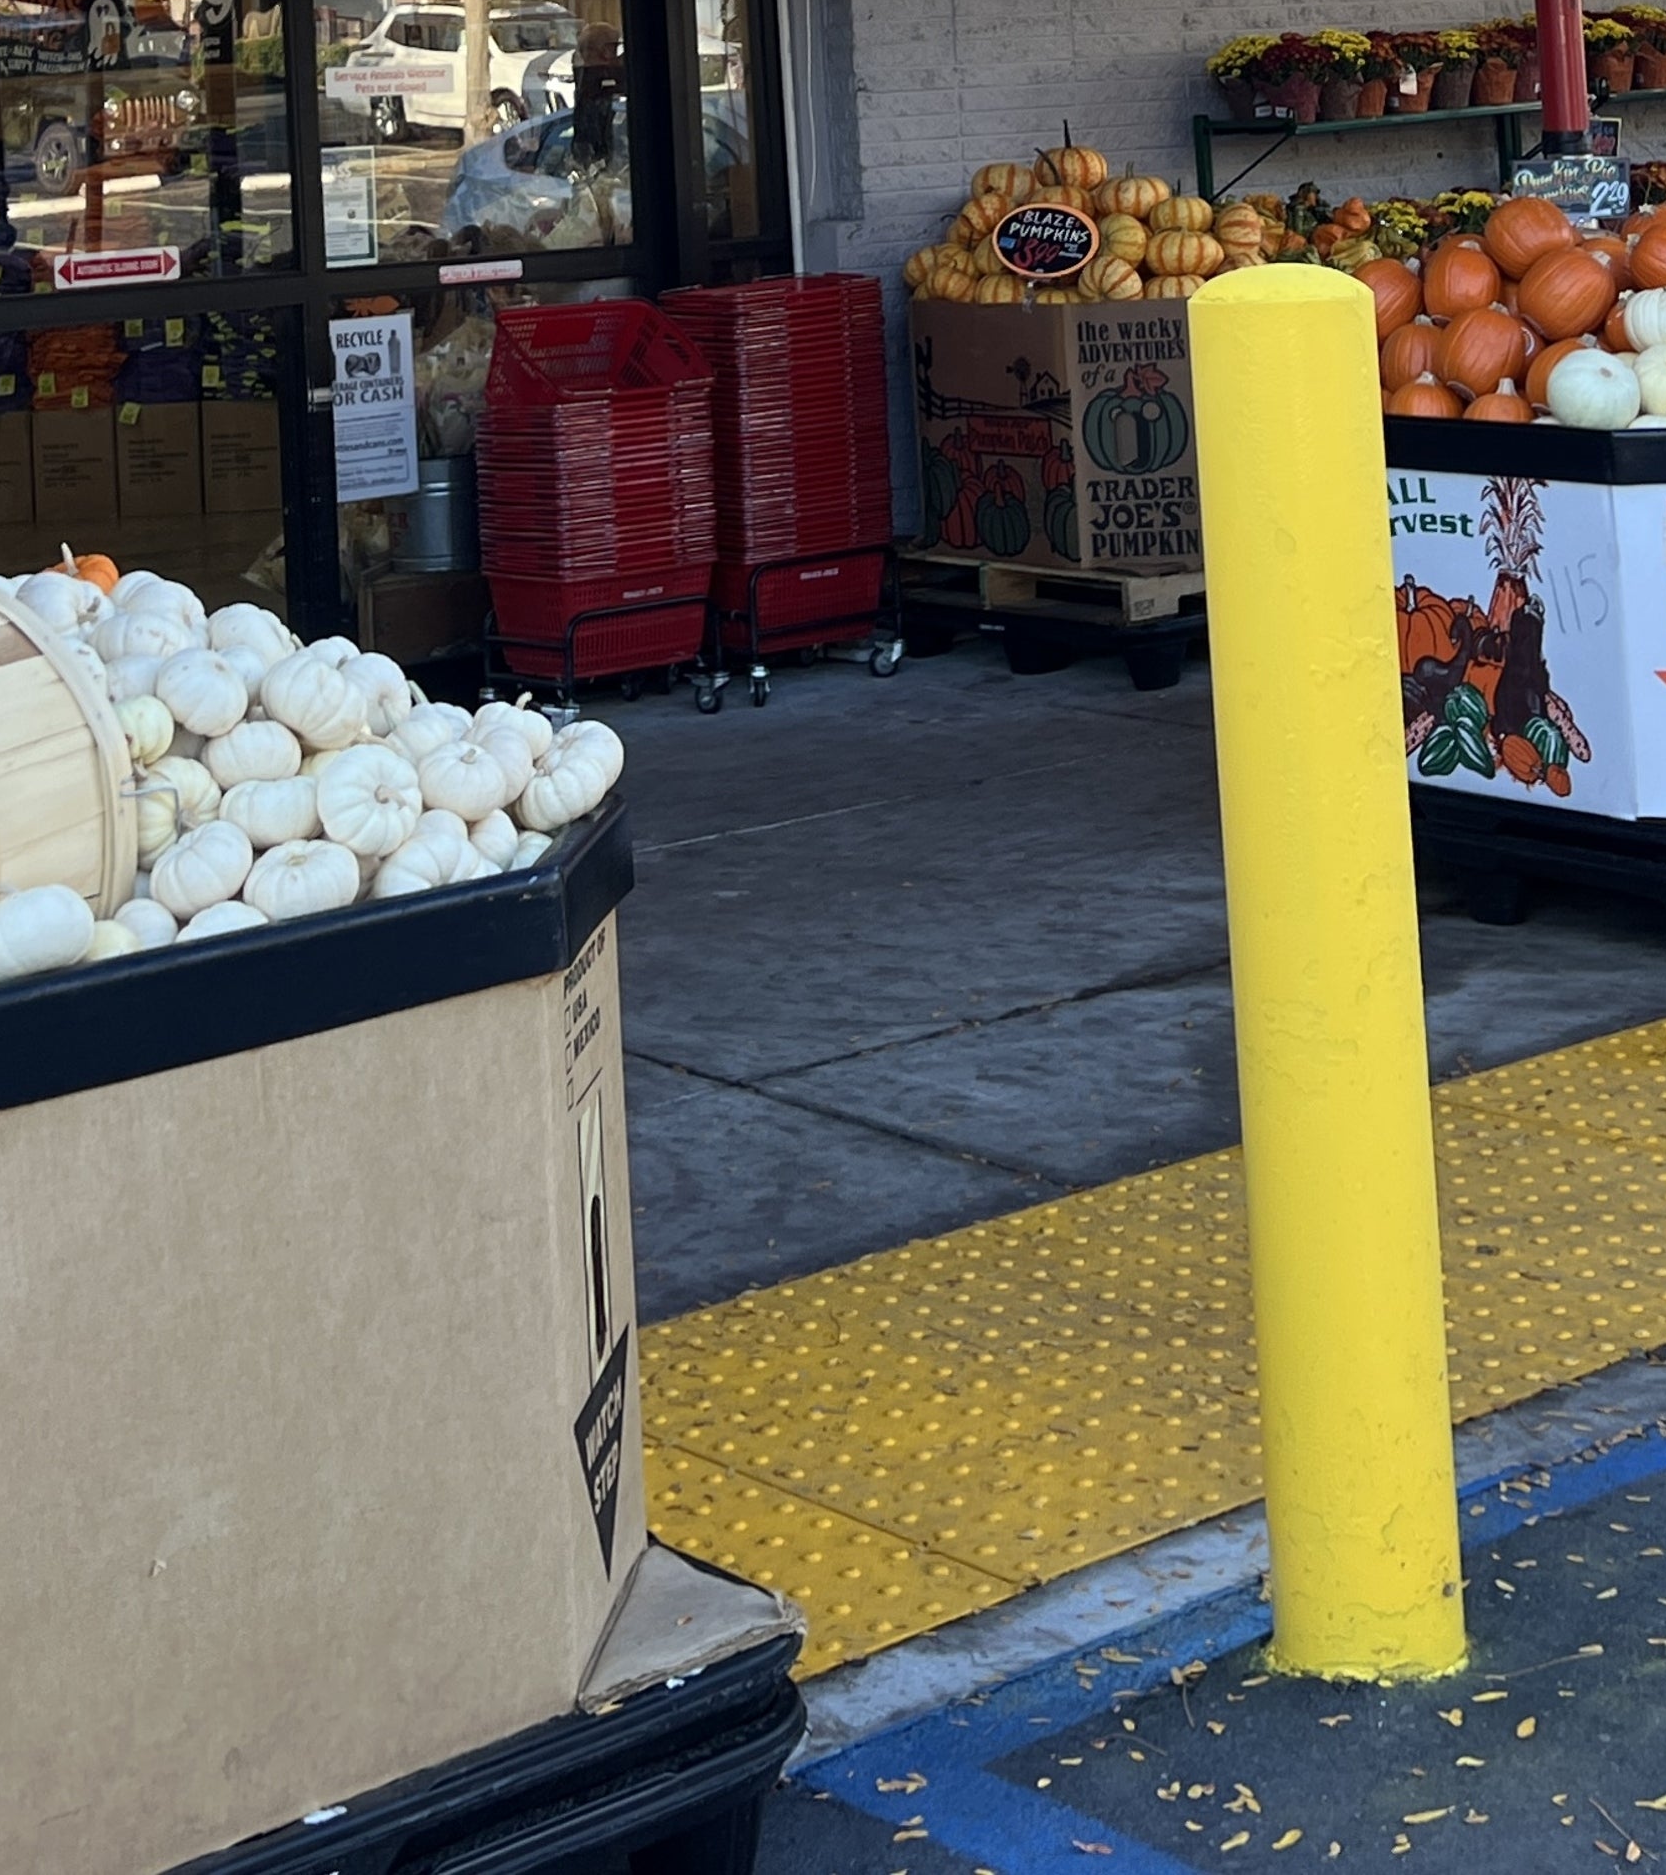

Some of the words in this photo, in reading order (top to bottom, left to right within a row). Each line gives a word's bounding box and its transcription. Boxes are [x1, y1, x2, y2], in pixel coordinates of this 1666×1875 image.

[333, 69, 368, 82] Service
[369, 69, 406, 81] Animals
[407, 67, 447, 79] Welcome
[354, 82, 376, 94] Pets
[377, 82, 392, 93] not
[394, 81, 427, 93] allowed
[1023, 210, 1076, 229] BLAZE
[1008, 221, 1090, 245] PUMPKINS
[336, 328, 384, 350] RECYCLE
[1077, 320, 1110, 343] the
[1116, 317, 1184, 342] wacky
[1077, 339, 1186, 365] ADVENTURES
[1080, 363, 1107, 389] of
[1103, 368, 1118, 384] a
[360, 386, 405, 404] CASH
[1085, 476, 1197, 504] TRADER
[1091, 528, 1202, 559] PUMPKIN
[562, 939, 596, 1000] PRODUCT
[596, 926, 606, 957] OF
[572, 988, 588, 1025] USA
[572, 1005, 601, 1062] MEXICO
[584, 1374, 623, 1472] WATCH
[593, 1439, 619, 1516] STEP
